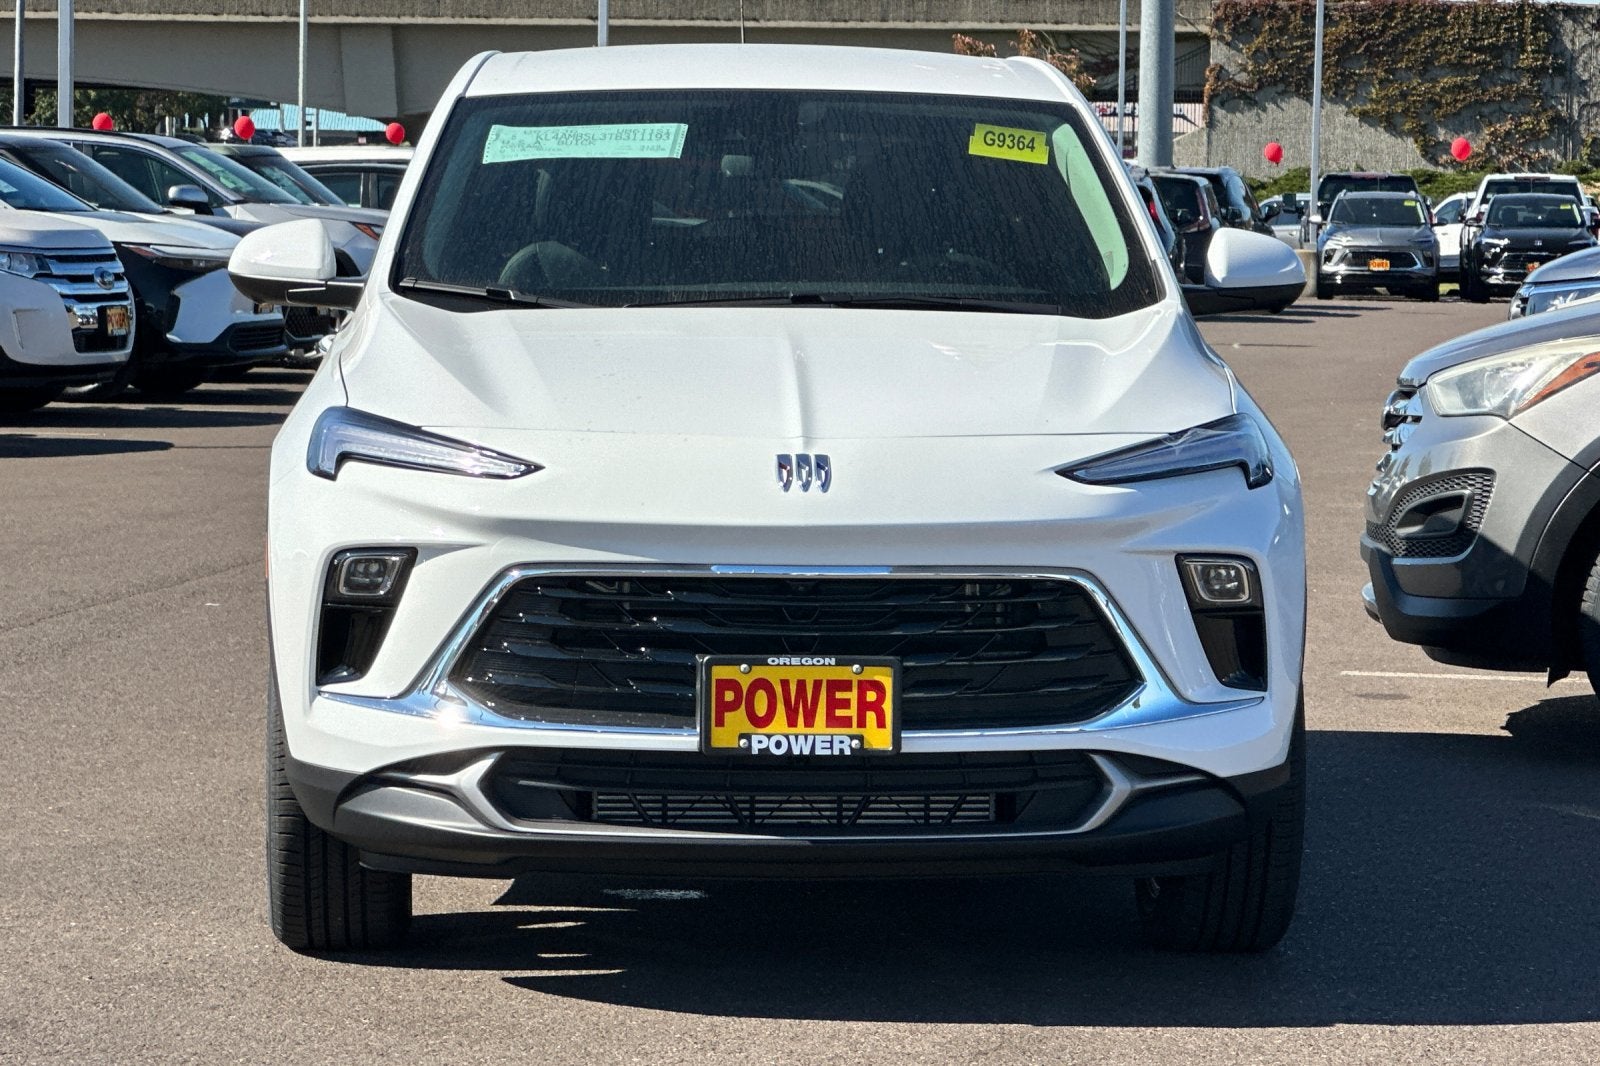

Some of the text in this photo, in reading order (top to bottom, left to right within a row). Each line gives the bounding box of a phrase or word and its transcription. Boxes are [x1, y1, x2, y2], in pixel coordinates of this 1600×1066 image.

[983, 130, 1036, 152] G9364
[767, 657, 836, 666] OREGON
[714, 677, 887, 728] POWER
[751, 734, 852, 756] POWER
